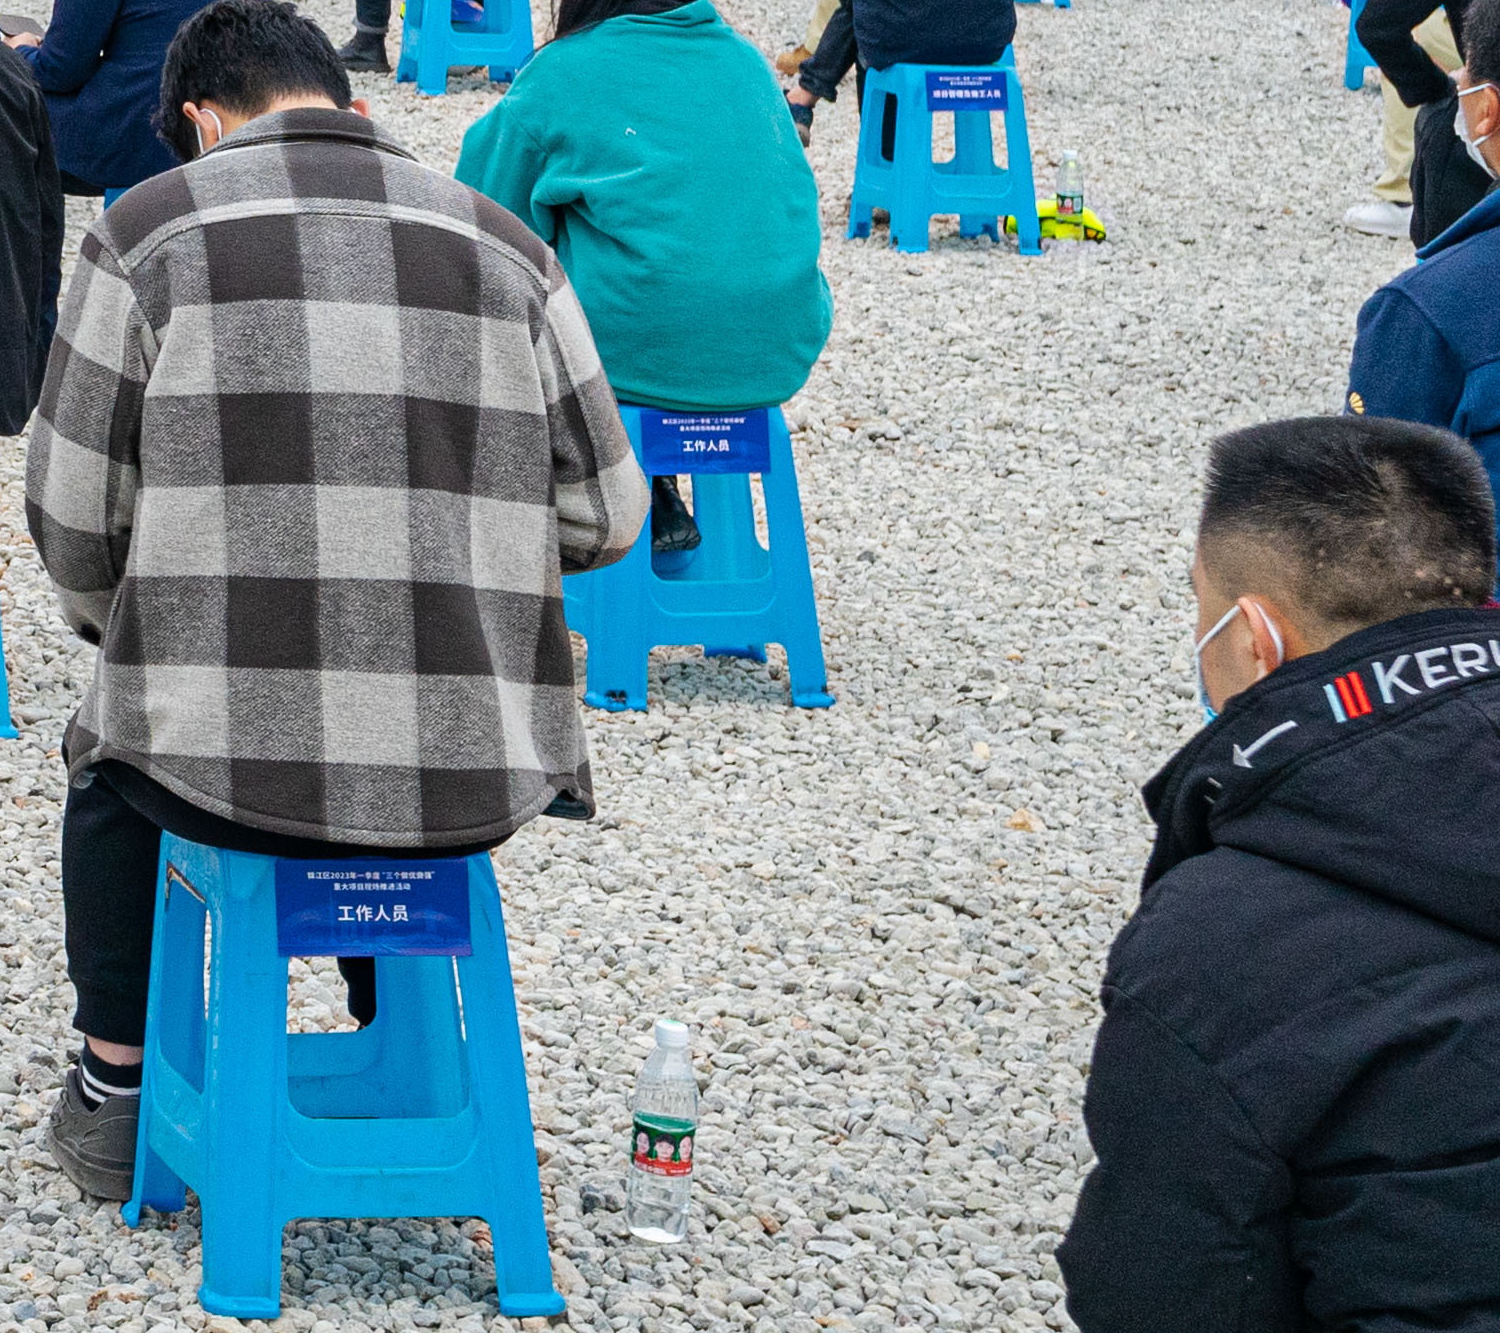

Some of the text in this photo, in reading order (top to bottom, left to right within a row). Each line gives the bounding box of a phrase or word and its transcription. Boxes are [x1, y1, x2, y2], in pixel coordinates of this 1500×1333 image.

[684, 440, 729, 451] 工作人员
[338, 905, 408, 921] 工作人员
